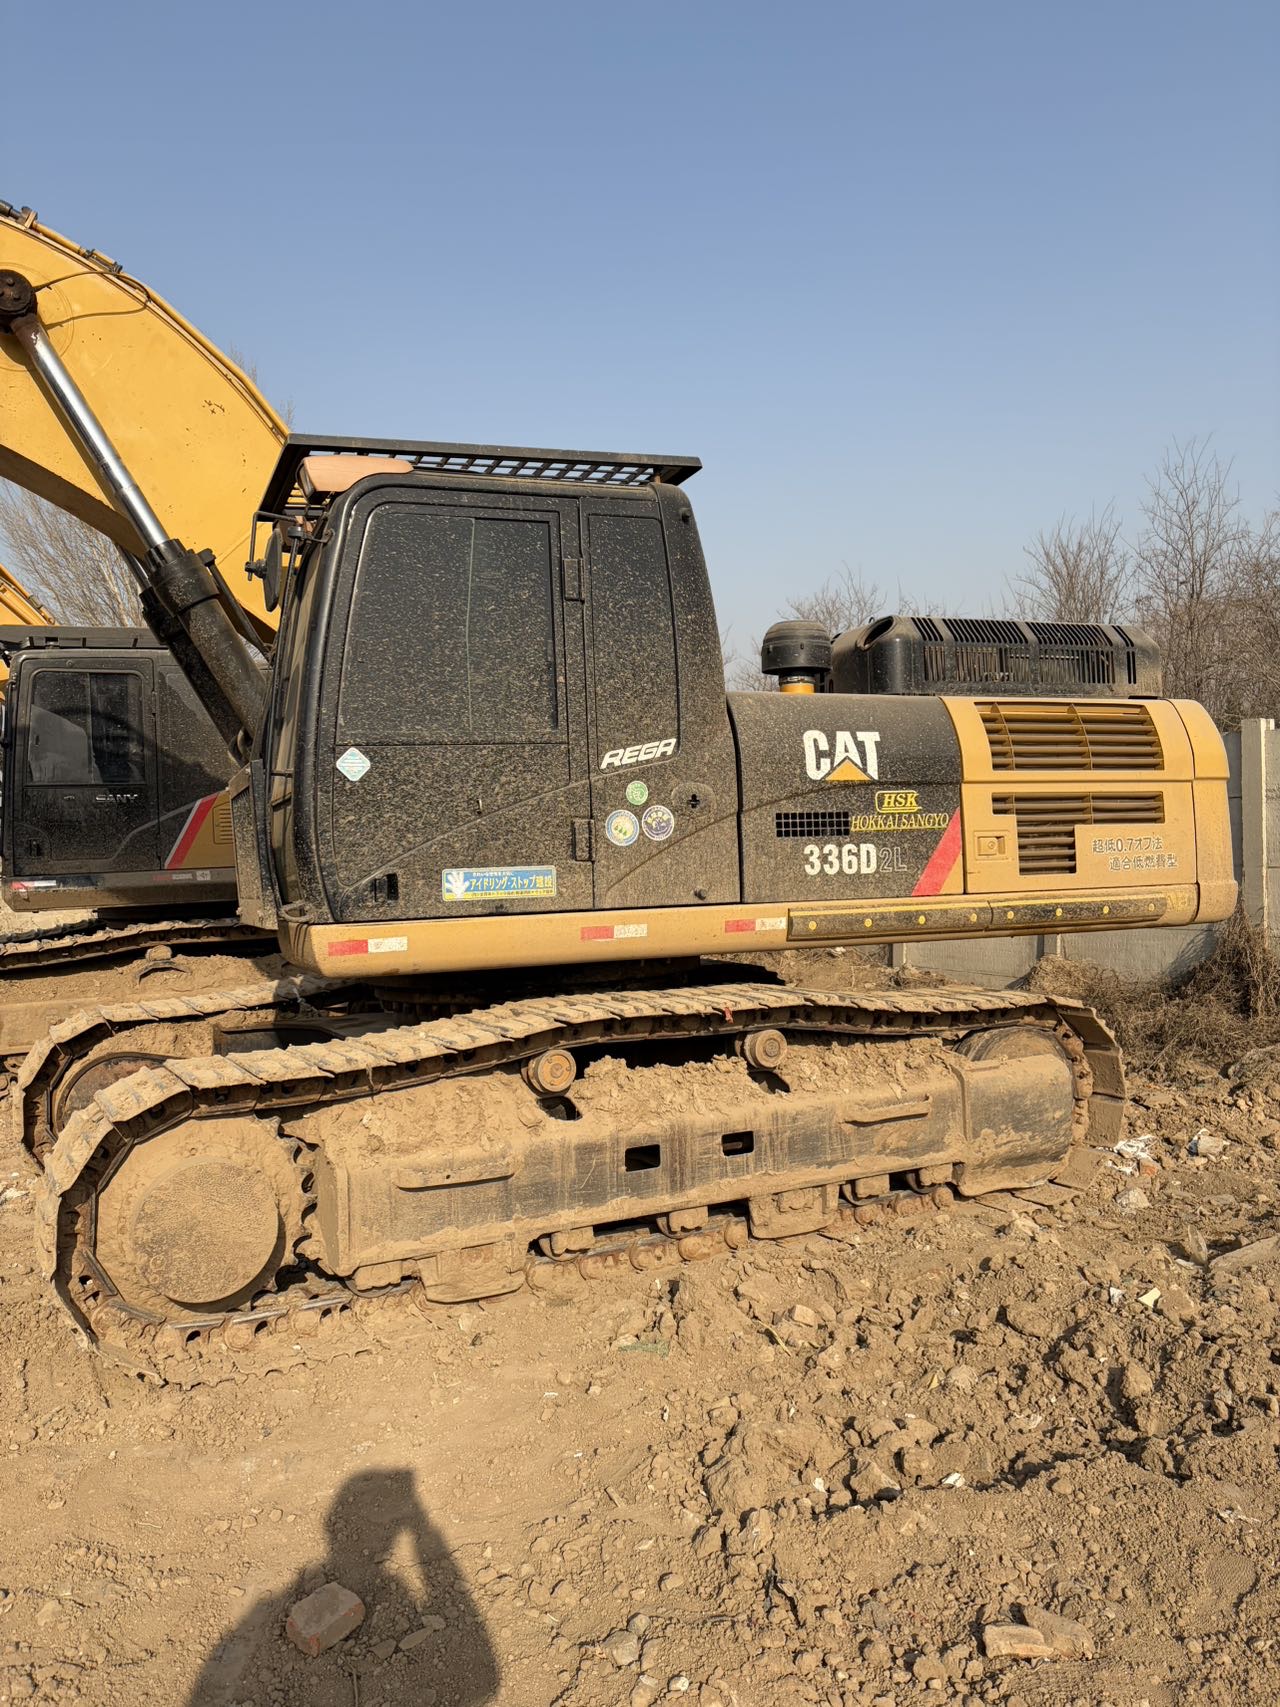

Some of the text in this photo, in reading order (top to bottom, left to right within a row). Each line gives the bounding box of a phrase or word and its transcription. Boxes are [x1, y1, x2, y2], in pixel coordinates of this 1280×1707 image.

[600, 738, 677, 769] REGA
[803, 730, 880, 780] CAT
[882, 793, 919, 808] HSK
